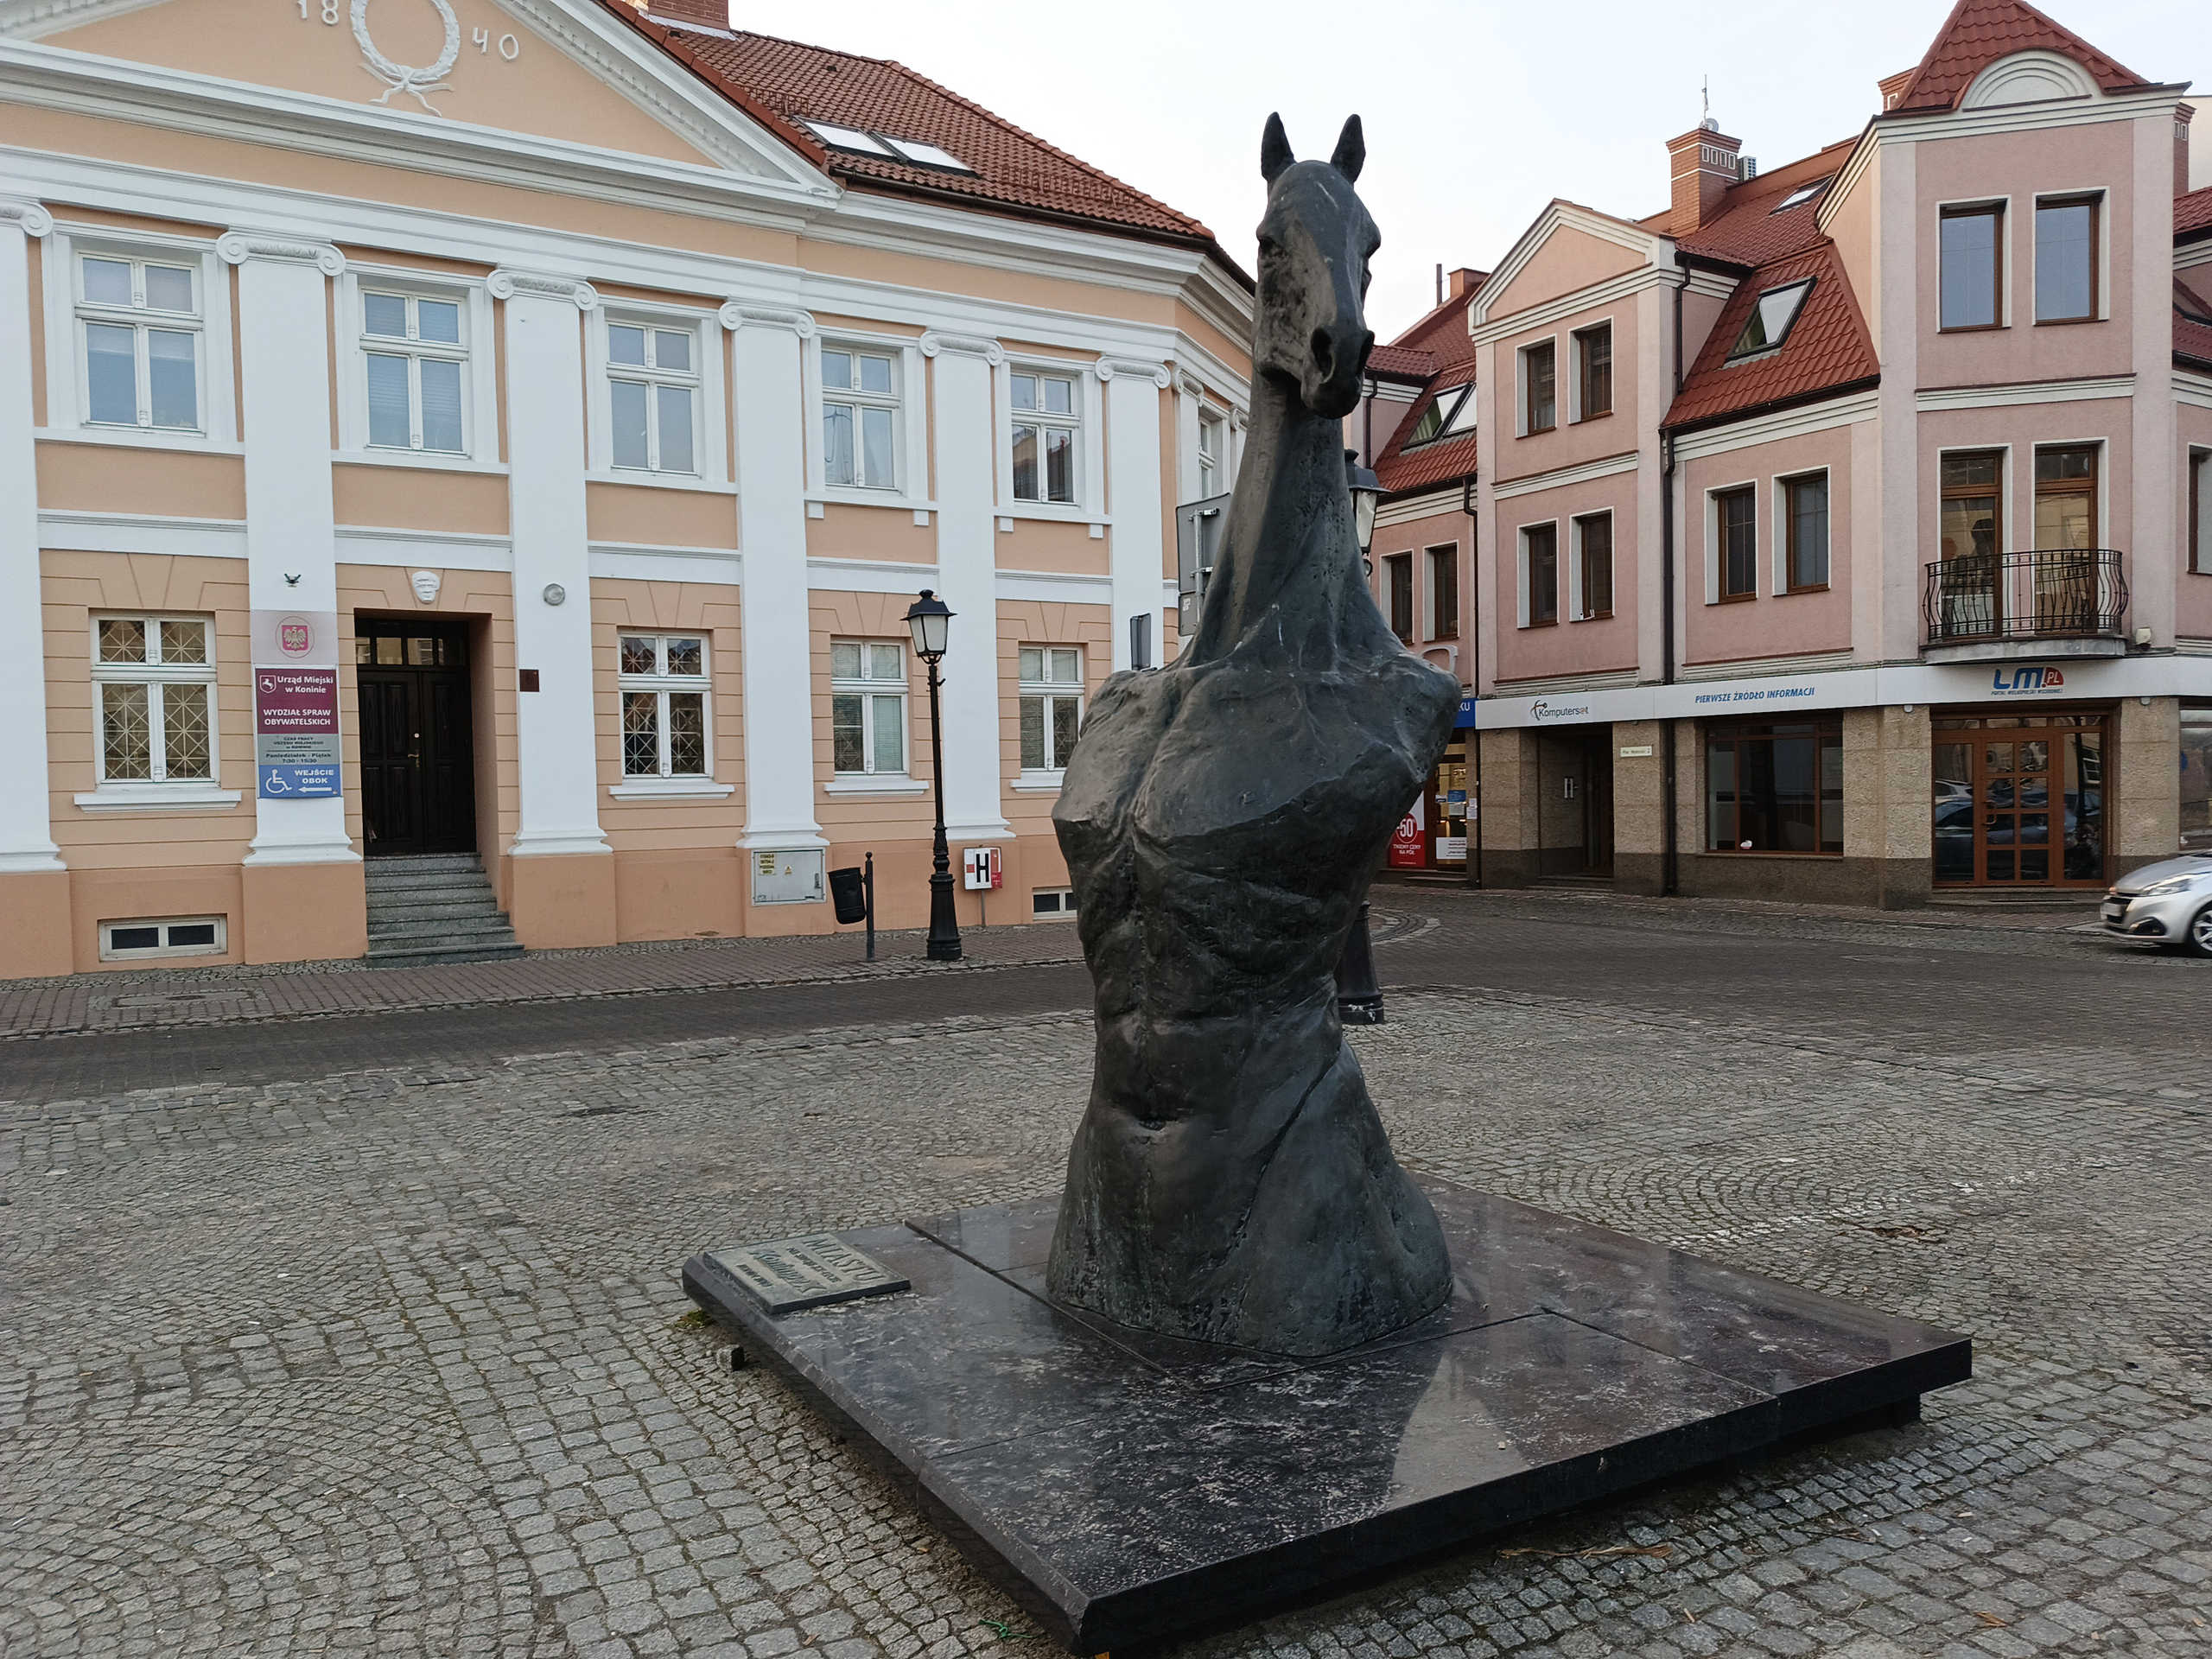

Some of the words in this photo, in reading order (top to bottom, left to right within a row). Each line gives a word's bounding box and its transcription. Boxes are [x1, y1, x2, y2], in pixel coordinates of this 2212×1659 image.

[472, 27, 519, 61] 40
[276, 676, 302, 684] Urząd
[303, 676, 334, 685] Miejski
[295, 685, 327, 694] Koninie
[1695, 693, 1732, 703] PIERWSZE
[1732, 690, 1764, 702] ŹRÓDŁO
[1766, 687, 1815, 699] INFORMACJI
[976, 853, 989, 882] H
[804, 1238, 887, 1281] MIASTU
